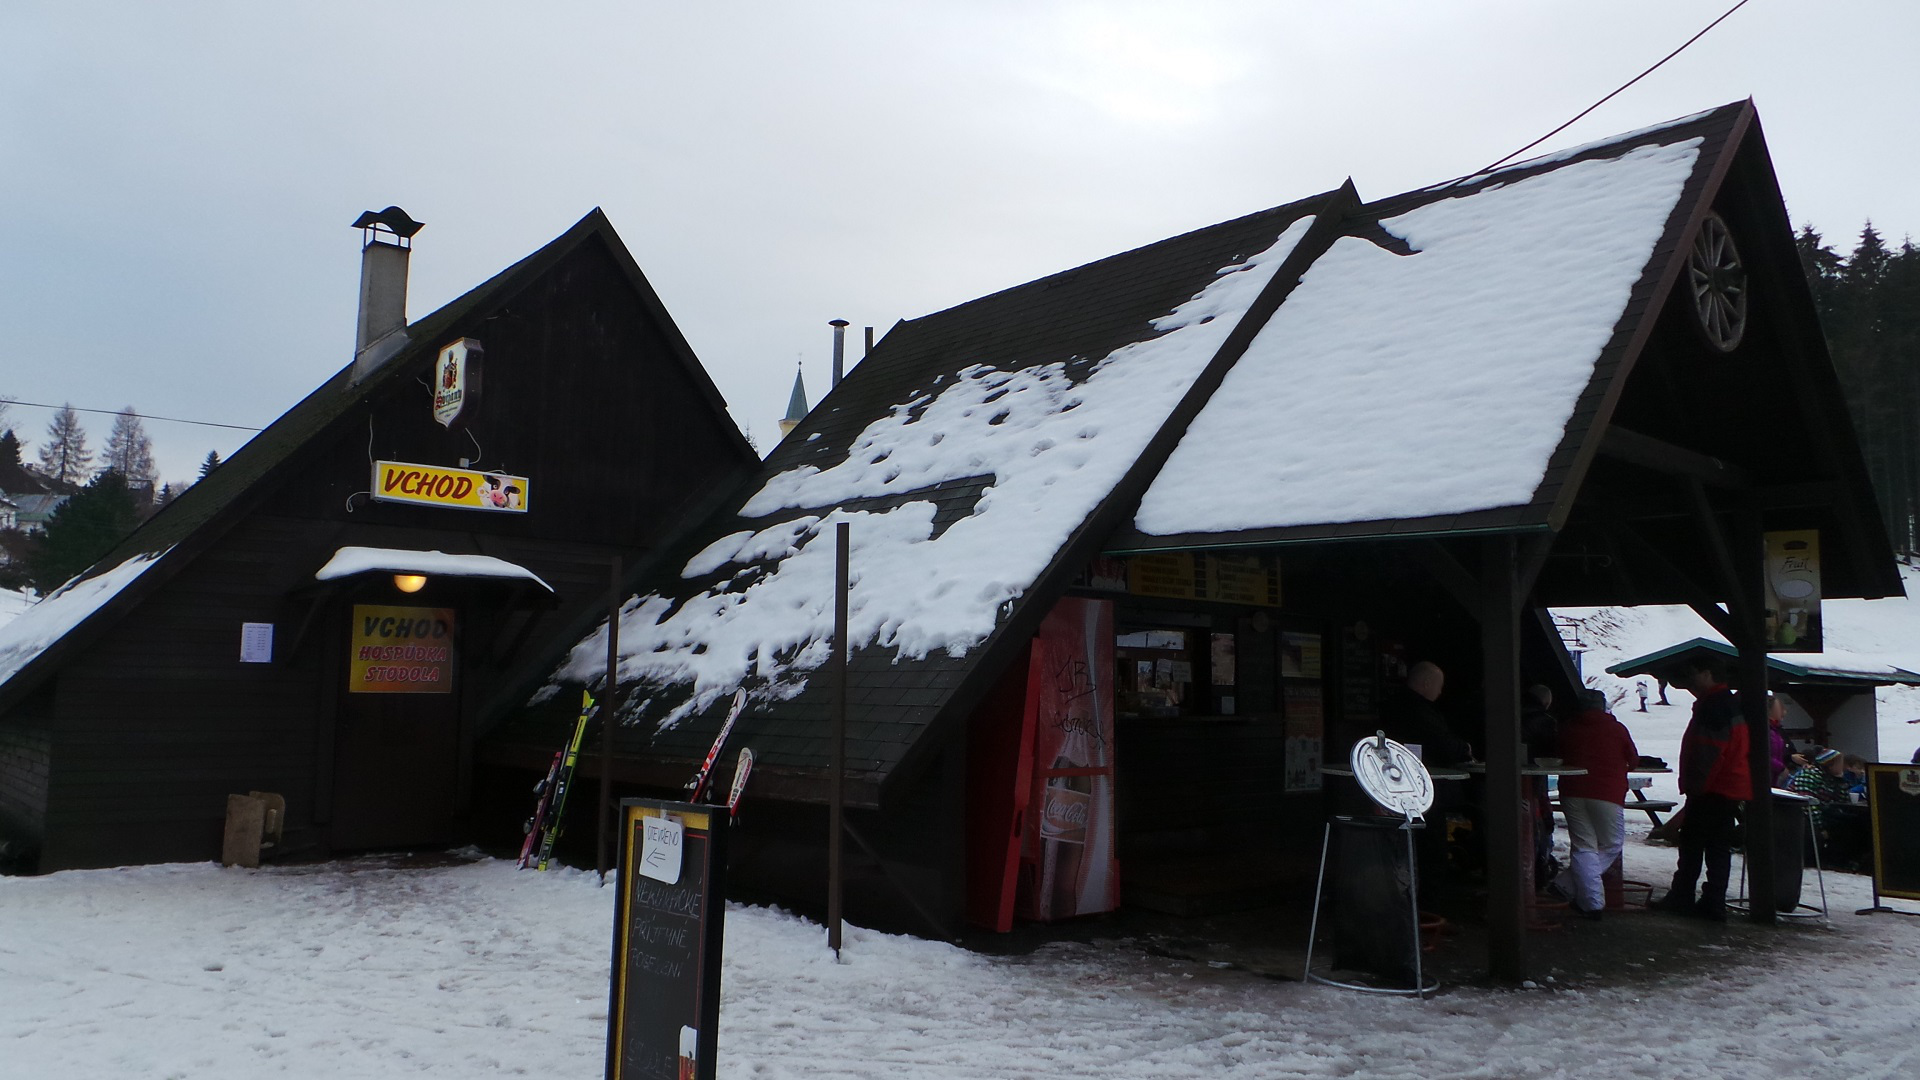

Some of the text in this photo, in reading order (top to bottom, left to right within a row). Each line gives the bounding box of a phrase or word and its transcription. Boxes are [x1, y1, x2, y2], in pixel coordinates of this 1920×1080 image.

[384, 468, 473, 500] VCHOD
[364, 616, 448, 638] VCHOD
[364, 666, 440, 682] STODOLA
